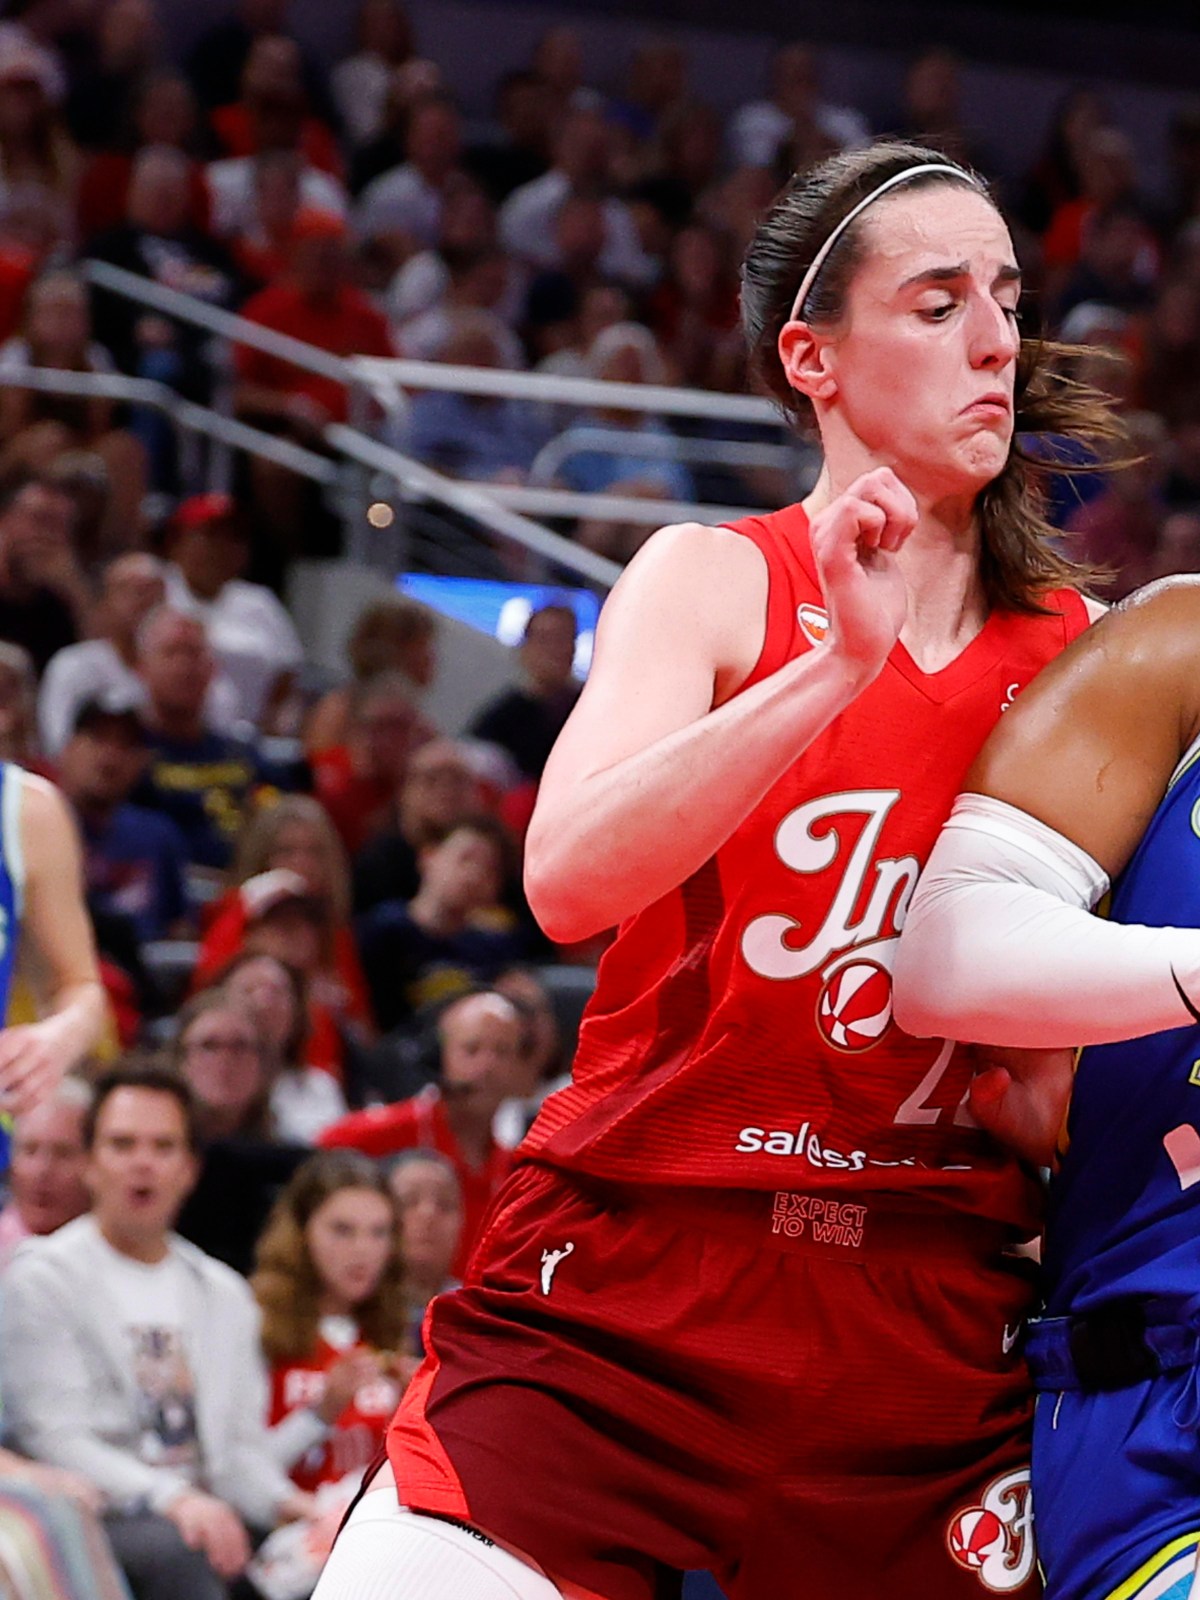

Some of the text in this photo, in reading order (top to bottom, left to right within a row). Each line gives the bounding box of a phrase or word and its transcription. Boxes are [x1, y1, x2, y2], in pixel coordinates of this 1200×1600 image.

[740, 788, 920, 980] In
[772, 1191, 868, 1228] EXPECT
[771, 1213, 864, 1248] TO WIN
